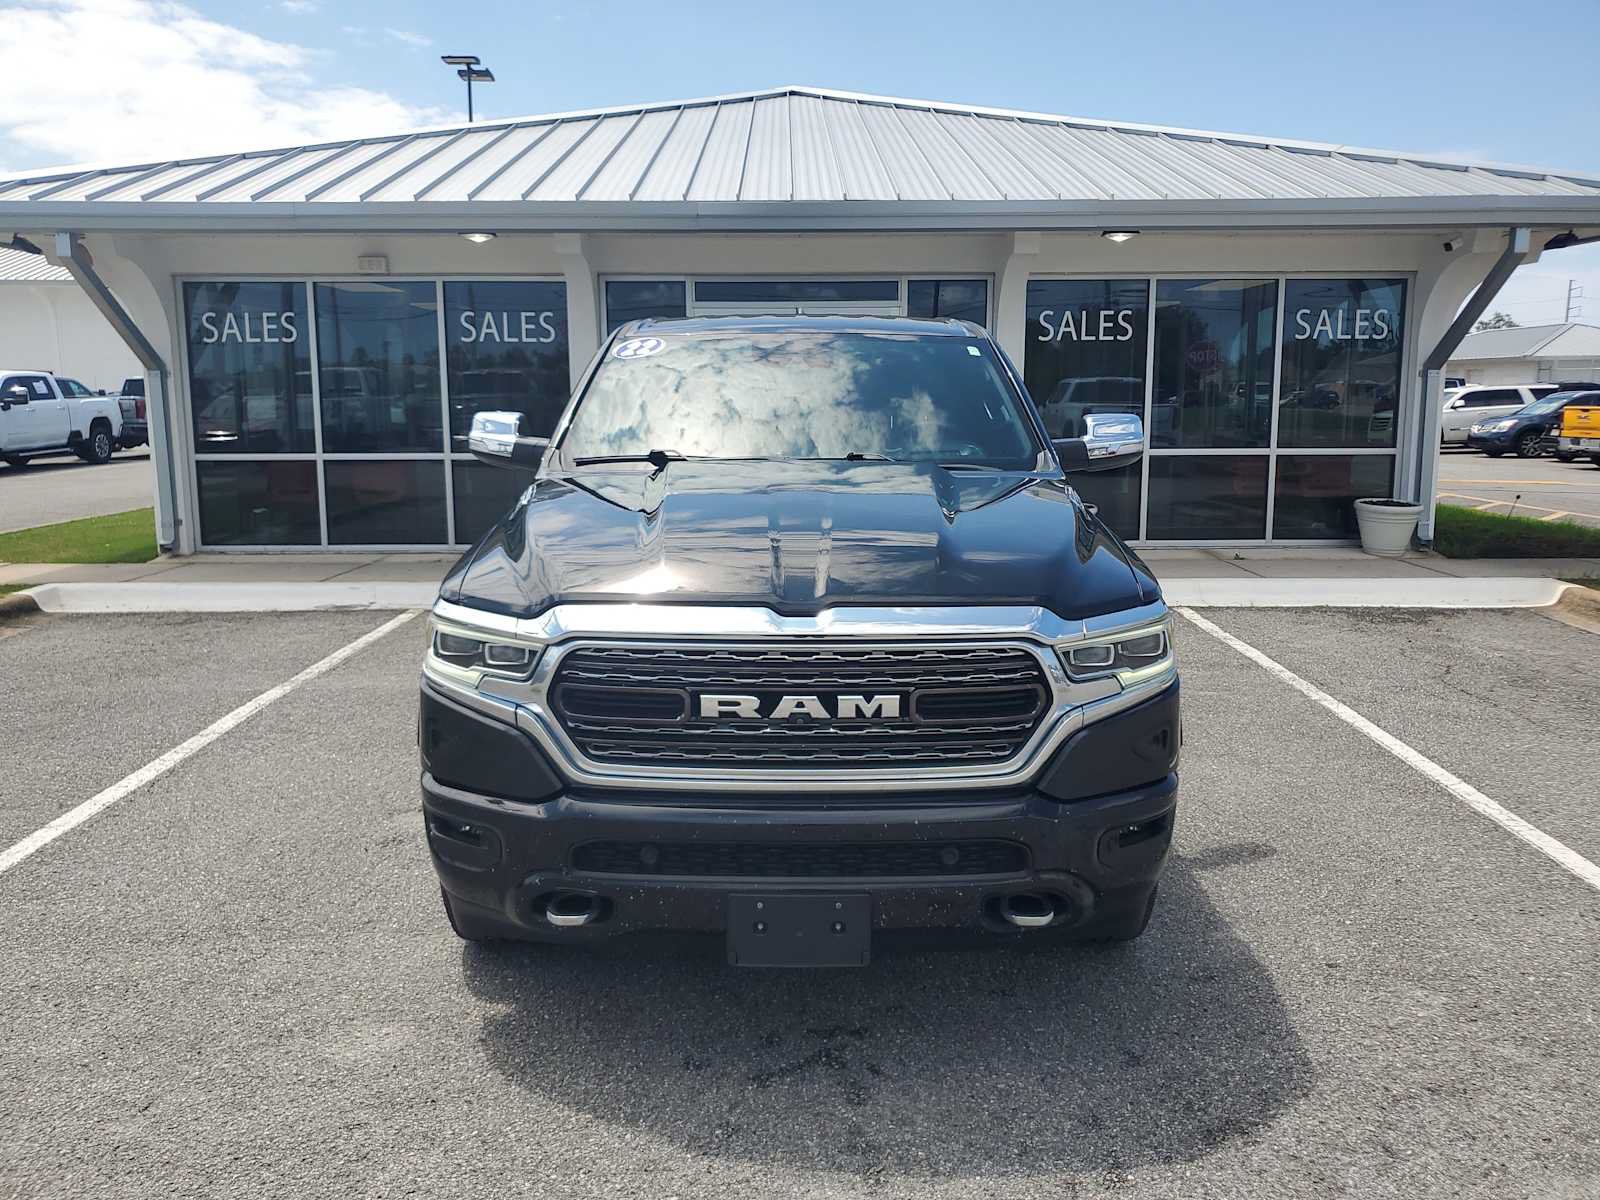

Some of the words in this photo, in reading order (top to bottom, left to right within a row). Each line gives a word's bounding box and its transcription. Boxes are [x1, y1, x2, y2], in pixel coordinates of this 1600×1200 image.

[201, 311, 298, 343] SALES
[460, 311, 556, 342] SALES
[1038, 310, 1133, 341] SALES
[1295, 308, 1389, 340] SALES
[700, 694, 901, 719] RAM
